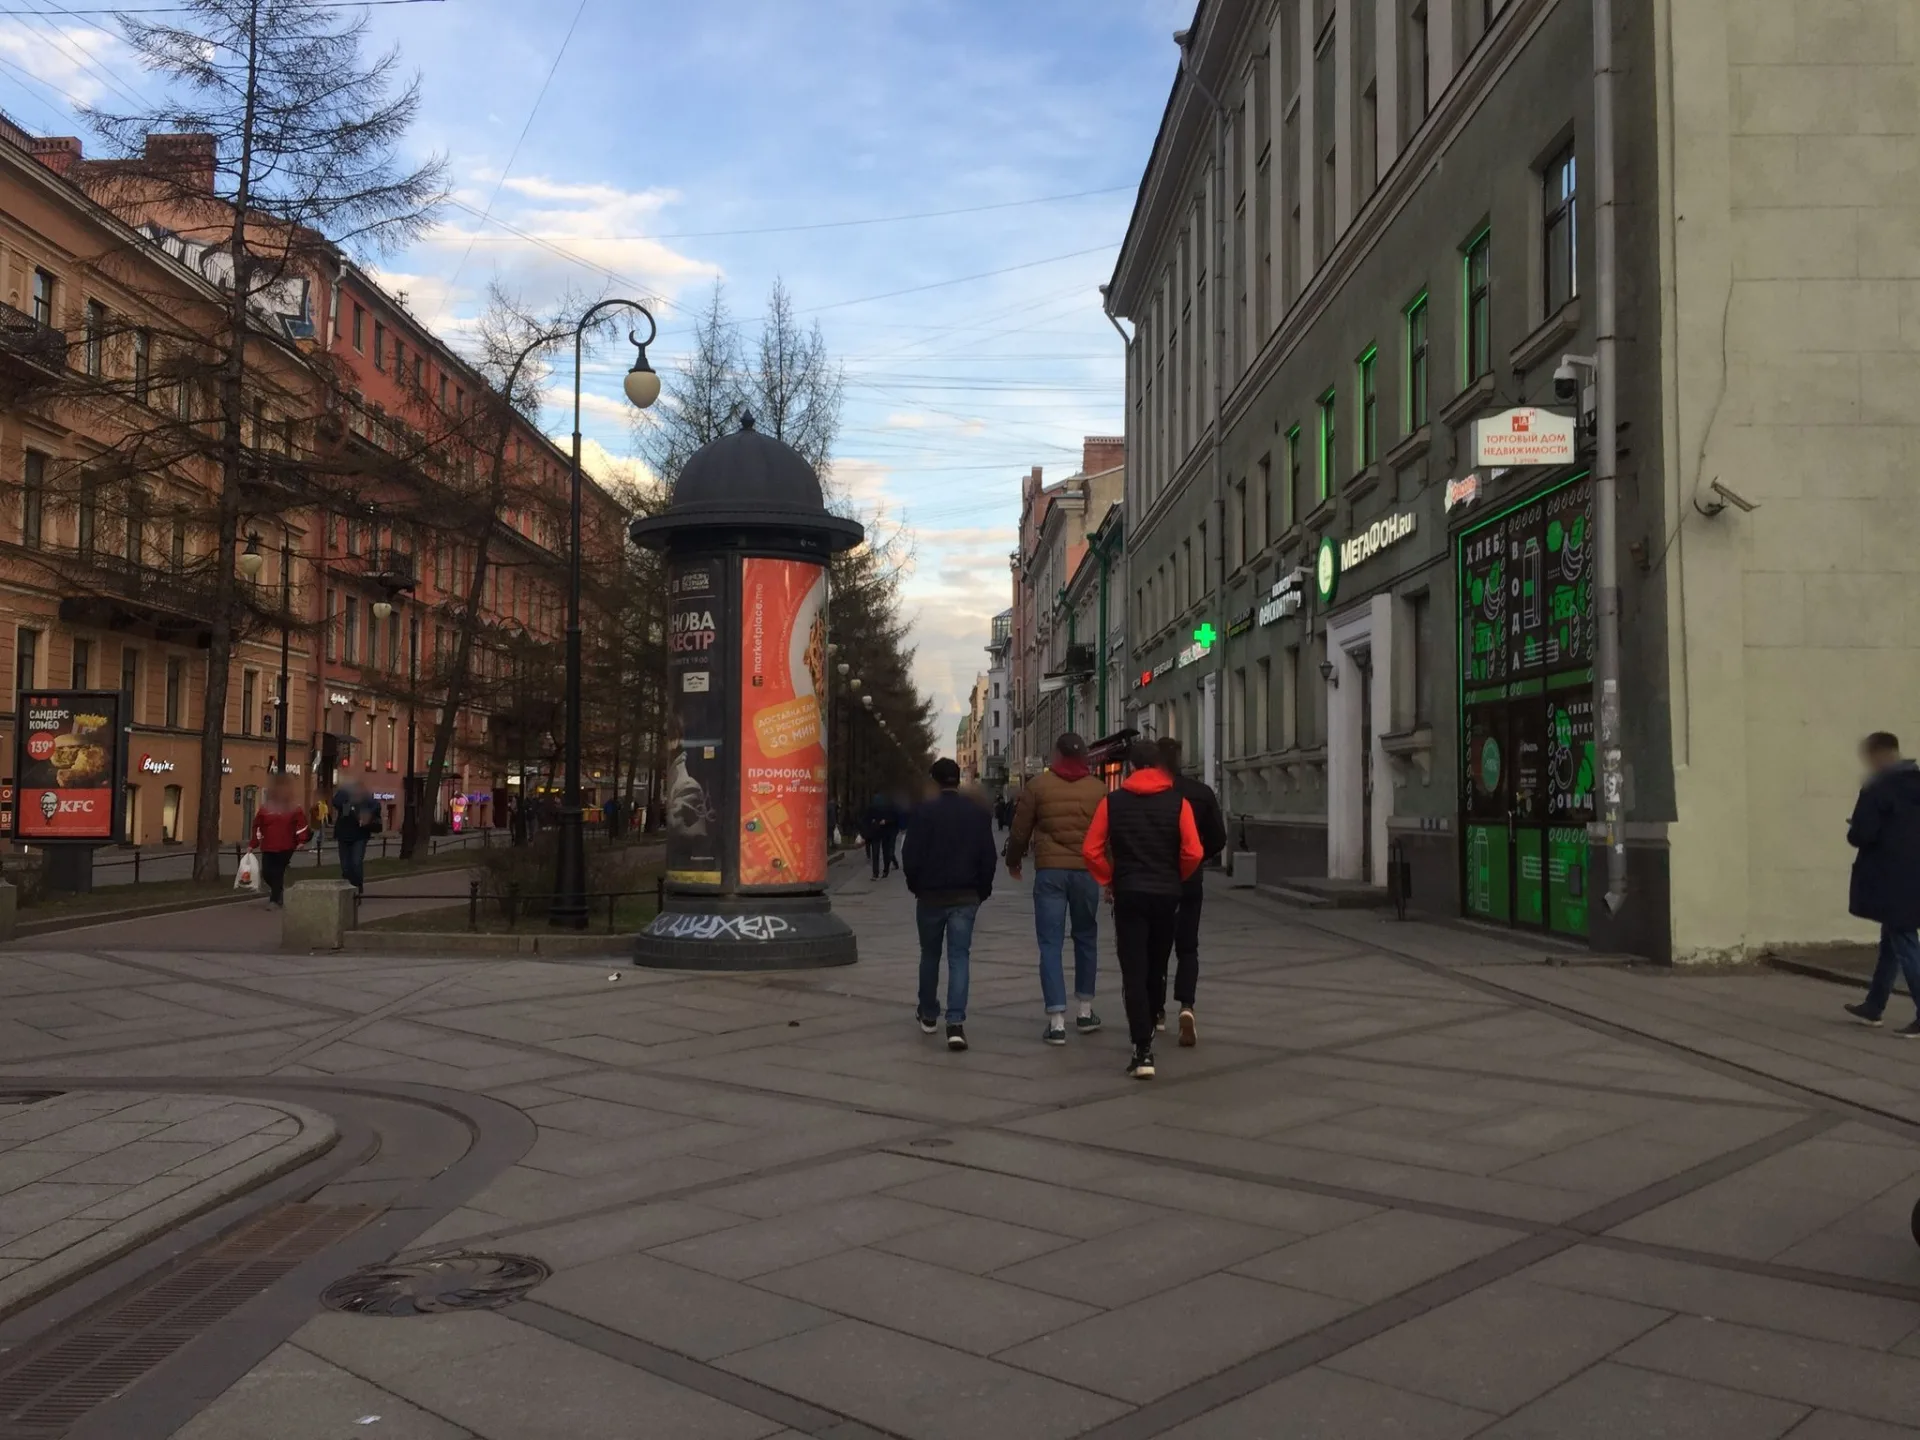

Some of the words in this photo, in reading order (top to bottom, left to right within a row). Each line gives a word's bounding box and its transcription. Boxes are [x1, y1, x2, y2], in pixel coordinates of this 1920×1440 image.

[1486, 434, 1538, 444] ТОРГОВЫЙ
[1540, 433, 1567, 443] ДОМ
[1483, 445, 1569, 456] НЕДВИЖИМОСТИ
[1466, 533, 1499, 565] ХЛЕБ
[29, 710, 70, 720] САНДЕРС
[758, 707, 800, 728] ДОСТАВКА
[29, 720, 60, 730] КОМБО
[770, 734, 788, 748] 30
[792, 723, 816, 741] МИН
[143, 756, 175, 774] Baggins
[748, 768, 812, 779] ПРОМОКОД
[58, 800, 95, 812] KFC
